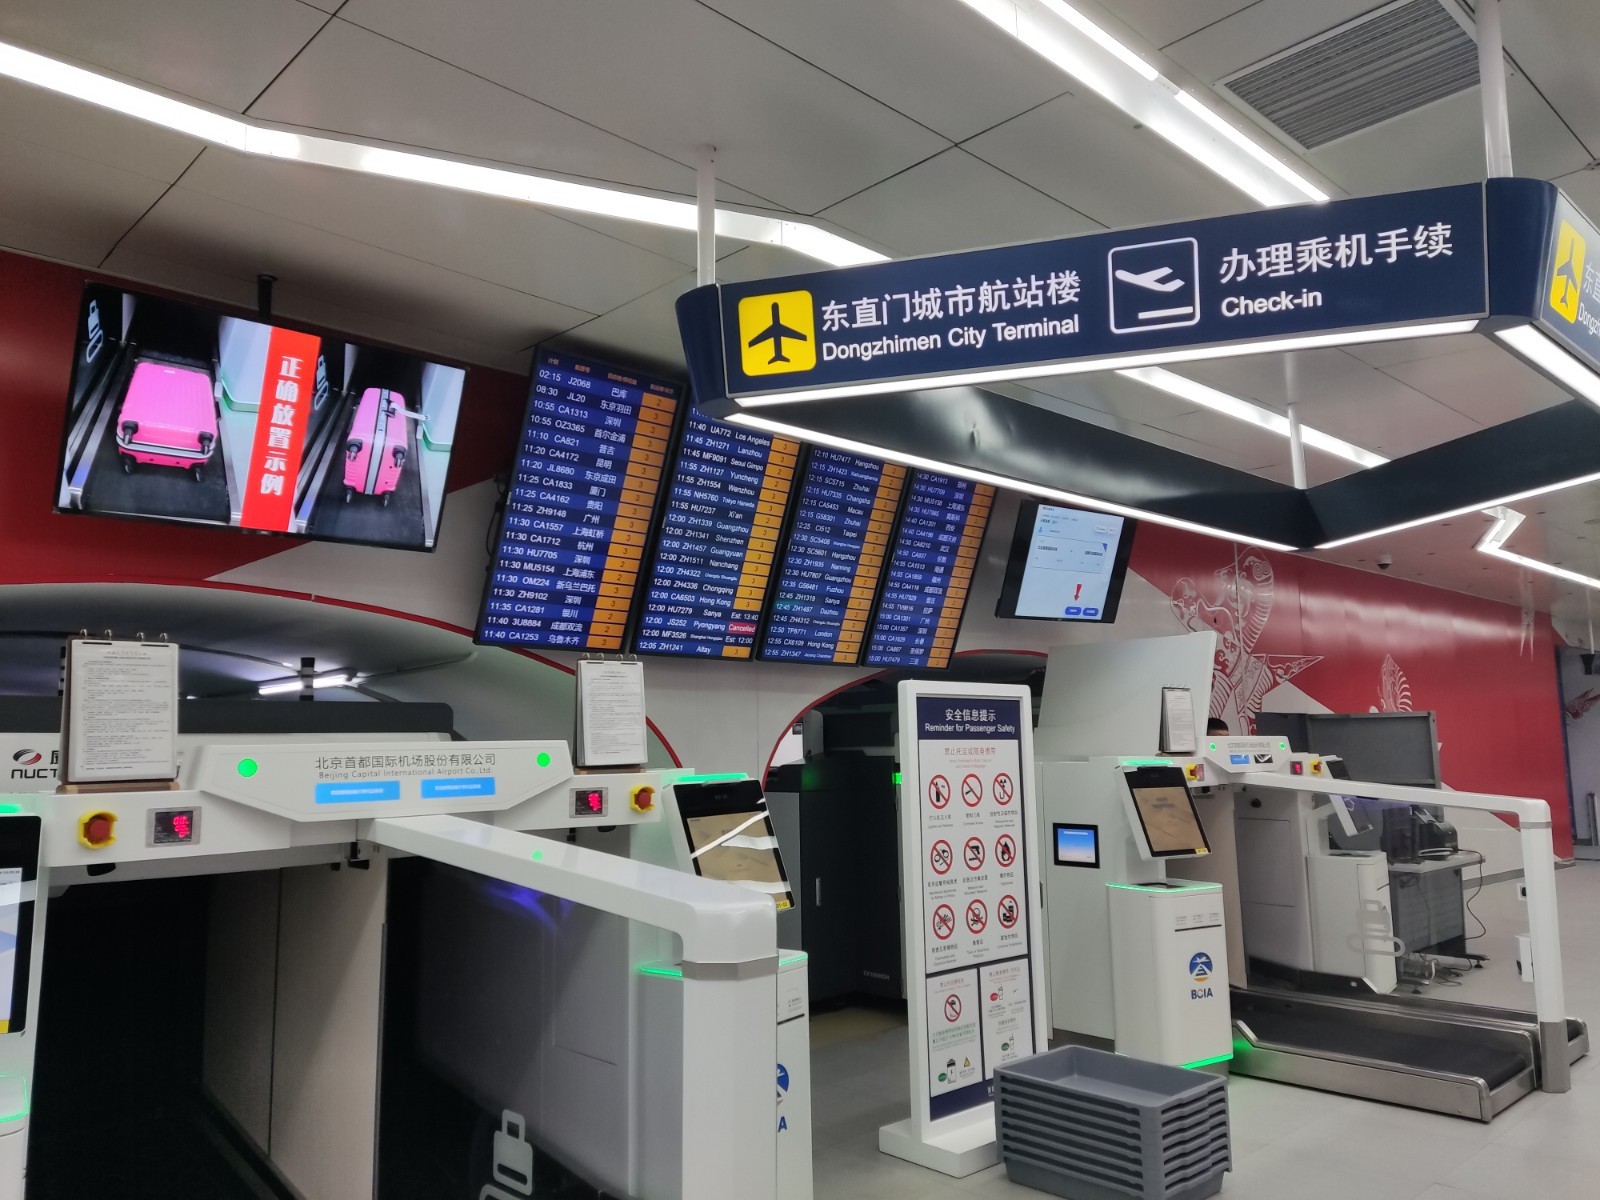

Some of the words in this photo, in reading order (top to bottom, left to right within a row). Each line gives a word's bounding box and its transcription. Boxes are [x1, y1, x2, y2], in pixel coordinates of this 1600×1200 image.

[1218, 221, 1453, 285] 办理乘机手续
[821, 269, 1082, 332] 东直门城市航站楼
[1220, 288, 1323, 319] Check-in
[822, 333, 941, 362] Dongzhimen
[948, 326, 987, 349] City
[992, 314, 1080, 342] Terminal
[539, 369, 561, 381] 02:15
[567, 376, 590, 388] J2068
[610, 387, 627, 398] 巴库
[536, 384, 558, 396] 08:30
[566, 392, 585, 402] JL20
[599, 399, 631, 415] 东京羽田
[534, 399, 555, 410] 10:55
[557, 404, 588, 418] CA1313
[604, 415, 621, 427] 深圳
[261, 355, 303, 496] 正确放置示例
[530, 414, 551, 425] 10:55
[554, 419, 585, 432] OZ3365
[527, 429, 548, 440] 11:10
[554, 434, 579, 446] CA821
[689, 420, 706, 431] 11:40
[710, 425, 731, 437] UA772
[735, 431, 746, 440] Los
[746, 434, 770, 446] Angeles
[525, 444, 545, 454] 11:20
[548, 448, 579, 461] CA4172
[686, 434, 703, 444] 11:45
[705, 438, 729, 450] ZH1271
[737, 445, 762, 457] Lanzhou
[683, 447, 700, 457] 11:45
[702, 451, 726, 463] MF9091
[730, 457, 746, 467] Seoul
[521, 458, 542, 469] 11:20
[546, 463, 574, 475] JL8680
[584, 470, 616, 484] 东京成田
[680, 461, 697, 470] 11:55
[699, 464, 724, 475] ZH1127
[518, 473, 539, 483] 11:25
[542, 477, 572, 489] CA1833
[677, 474, 694, 483] 11:55
[696, 477, 721, 488] ZH1554
[515, 488, 536, 498] 11:25
[539, 491, 570, 503] CA4162
[674, 487, 691, 496] 11:55
[693, 490, 718, 501] NH5760
[512, 502, 533, 512] 11:25
[535, 505, 566, 517] ZH9148
[582, 513, 600, 524] 广州
[671, 500, 688, 509] 11:55
[690, 503, 716, 514] HU7237
[509, 516, 530, 526] 11:30
[533, 520, 563, 531] CA1557
[571, 526, 604, 538] 上海虹桥
[668, 513, 685, 522] 12:00
[687, 516, 712, 526] ZH1339
[716, 521, 749, 533] Guangzhou
[506, 531, 527, 540] 11:30
[530, 534, 560, 545] CA1712
[577, 540, 594, 551] 杭州
[665, 526, 682, 535] 12:00
[684, 529, 709, 539] ZH1341
[715, 534, 744, 545] Shenzhen
[662, 539, 680, 548] 12:00
[681, 542, 706, 551] ZH1457
[502, 545, 524, 554] 11:30
[526, 548, 557, 559] HU7705
[573, 554, 591, 565] 深圳
[660, 552, 677, 561] 12:00
[678, 554, 703, 564] ZH1511
[709, 559, 738, 570] Nanchang
[499, 559, 521, 569] 11:30
[522, 562, 554, 573] MU5154
[657, 565, 674, 573] 12:00
[676, 567, 701, 577] ZH4322
[496, 573, 518, 582] 11:30
[522, 576, 549, 586] OM224
[555, 580, 595, 592] 新乌兰巴托
[654, 578, 671, 586] 12:00
[673, 580, 698, 589] ZH4336
[702, 583, 733, 595] Chongqing
[494, 588, 515, 596] 11:30
[517, 590, 548, 600] ZH9102
[564, 594, 581, 604] 深圳
[651, 590, 668, 598] 12:00
[670, 592, 695, 601] CA6503
[698, 596, 715, 605] Hong
[715, 598, 731, 607] Kong
[490, 602, 511, 610] 11:35
[514, 604, 544, 613] CA1281
[648, 603, 665, 611] 12:00
[667, 605, 692, 614] HU7279
[702, 608, 721, 618] Sanya
[487, 616, 508, 624] 11:40
[511, 617, 541, 627] 3U8884
[645, 616, 662, 624] 12:00
[666, 618, 687, 626] JS252
[693, 620, 725, 631] Pyongyang
[728, 623, 756, 632] Cancelled
[484, 630, 505, 638] 11:40
[508, 631, 539, 640] CA1253
[547, 634, 579, 645] 乌鲁木齐
[661, 630, 686, 638] MF3526
[639, 641, 657, 649] 12:05
[658, 642, 683, 650] ZH1241
[945, 708, 996, 722] 安全信息提示
[925, 723, 954, 732] Reminder
[955, 723, 964, 732] for
[965, 724, 996, 734] Passenger
[997, 724, 1015, 734] Safety
[314, 753, 496, 770] 北京首都国际机场股份有限公司
[318, 771, 349, 780] Beijing
[351, 770, 381, 779] Capital
[383, 768, 434, 777] International
[437, 767, 463, 776] Airport
[1191, 987, 1214, 1000] BCIA
